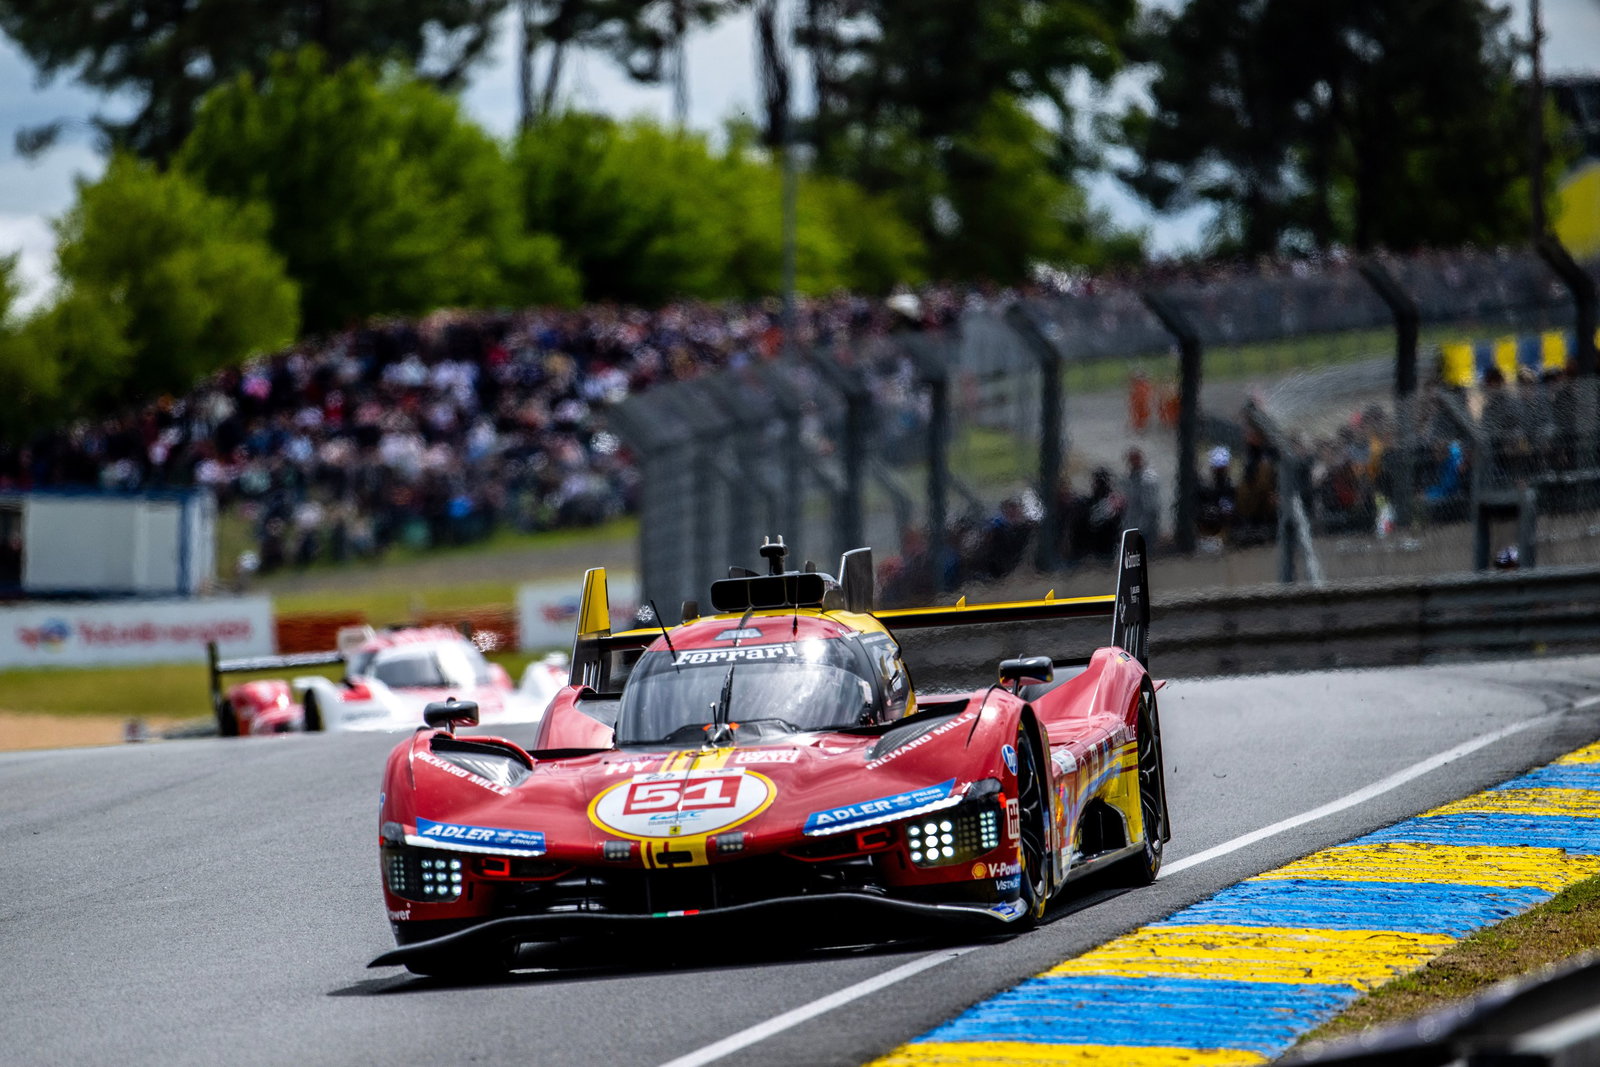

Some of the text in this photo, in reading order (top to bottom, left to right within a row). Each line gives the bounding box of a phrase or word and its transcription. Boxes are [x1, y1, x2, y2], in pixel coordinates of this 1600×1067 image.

[671, 643, 797, 666] Ferrari
[865, 712, 978, 770] RICHARD MILLE
[415, 751, 512, 797] RICHARD MILLE
[630, 779, 731, 811] 51
[816, 800, 892, 825] ADLER
[422, 824, 496, 841] ADLER
